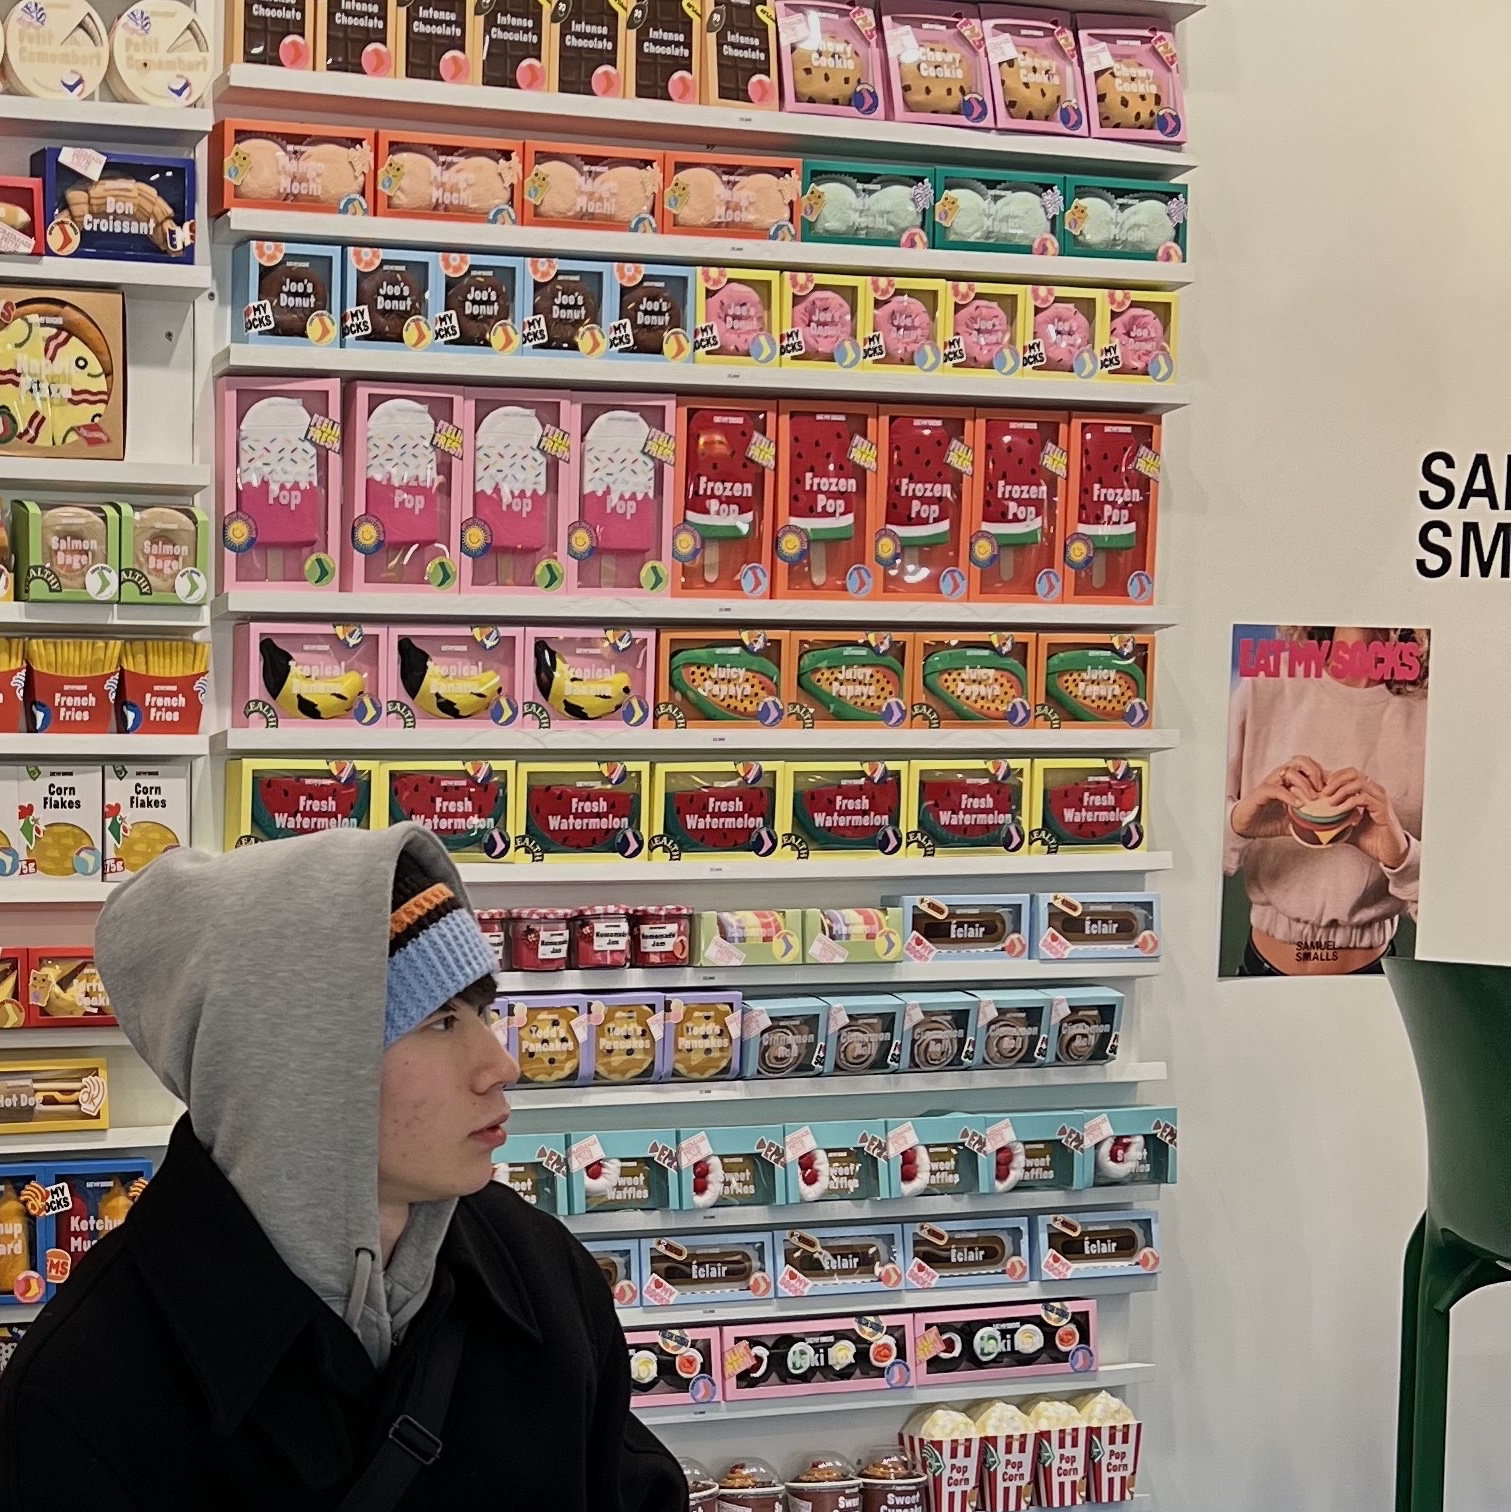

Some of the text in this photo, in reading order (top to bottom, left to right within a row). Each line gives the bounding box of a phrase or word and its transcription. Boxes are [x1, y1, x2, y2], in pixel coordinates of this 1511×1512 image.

[418, 6, 457, 21] Intense
[497, 13, 534, 28] Intense
[413, 20, 462, 37] Chocolate
[491, 27, 538, 44] Chocolate
[571, 21, 608, 36] Intense
[649, 28, 684, 43] Intense
[565, 35, 613, 51] Chocolate
[643, 40, 689, 57] Chocolate
[919, 46, 961, 67] Chewy
[919, 61, 964, 79] Cookie
[1113, 63, 1154, 81] Chewy
[1114, 77, 1157, 94] Cookie
[106, 198, 134, 214] Don
[83, 214, 155, 235] Croissant
[280, 293, 315, 307] Donut
[377, 297, 411, 311] Donut
[465, 301, 499, 315] Donut
[250, 304, 268, 318] MY
[552, 305, 586, 319] Donut
[805, 473, 856, 492] Frozen
[901, 478, 951, 498] Frozen
[1418, 451, 1511, 511] SA
[997, 481, 1047, 499] Frozen
[1093, 484, 1140, 502] Frozen
[817, 495, 845, 518] Pop
[911, 501, 939, 522] Pop
[1008, 502, 1036, 522] Pop
[1103, 506, 1129, 524] Pop
[52, 536, 97, 552] Salmon
[143, 540, 189, 557] Salmon
[55, 550, 92, 567] Bagel
[148, 554, 183, 571] Bagel
[1239, 637, 1421, 682] EAT MY SOCKS
[134, 783, 162, 796] Corn
[129, 795, 167, 809] Flakes
[298, 796, 336, 813] Fresh
[571, 797, 607, 813] Fresh
[708, 797, 744, 813] Fresh
[835, 796, 870, 812] Fresh
[274, 813, 358, 829] Watermelon
[548, 815, 629, 830] Watermelon
[686, 813, 764, 830] Watermelon
[813, 812, 889, 828] Watermelon
[950, 919, 986, 939] Éclair
[1084, 916, 1119, 938] Éclair
[1295, 940, 1338, 952] SAMUEL
[1295, 950, 1339, 962] SMALLS
[692, 1260, 727, 1281] Éclair
[1005, 1457, 1023, 1473] Pop
[1059, 1453, 1076, 1469] Pop
[1109, 1449, 1126, 1465] Pop
[950, 1462, 969, 1479] Pop
[1057, 1464, 1078, 1479] Corn
[1107, 1460, 1128, 1475] Corn
[947, 1475, 969, 1487] Corn
[1002, 1469, 1024, 1484] Corn
[887, 1491, 920, 1508] Sweet
